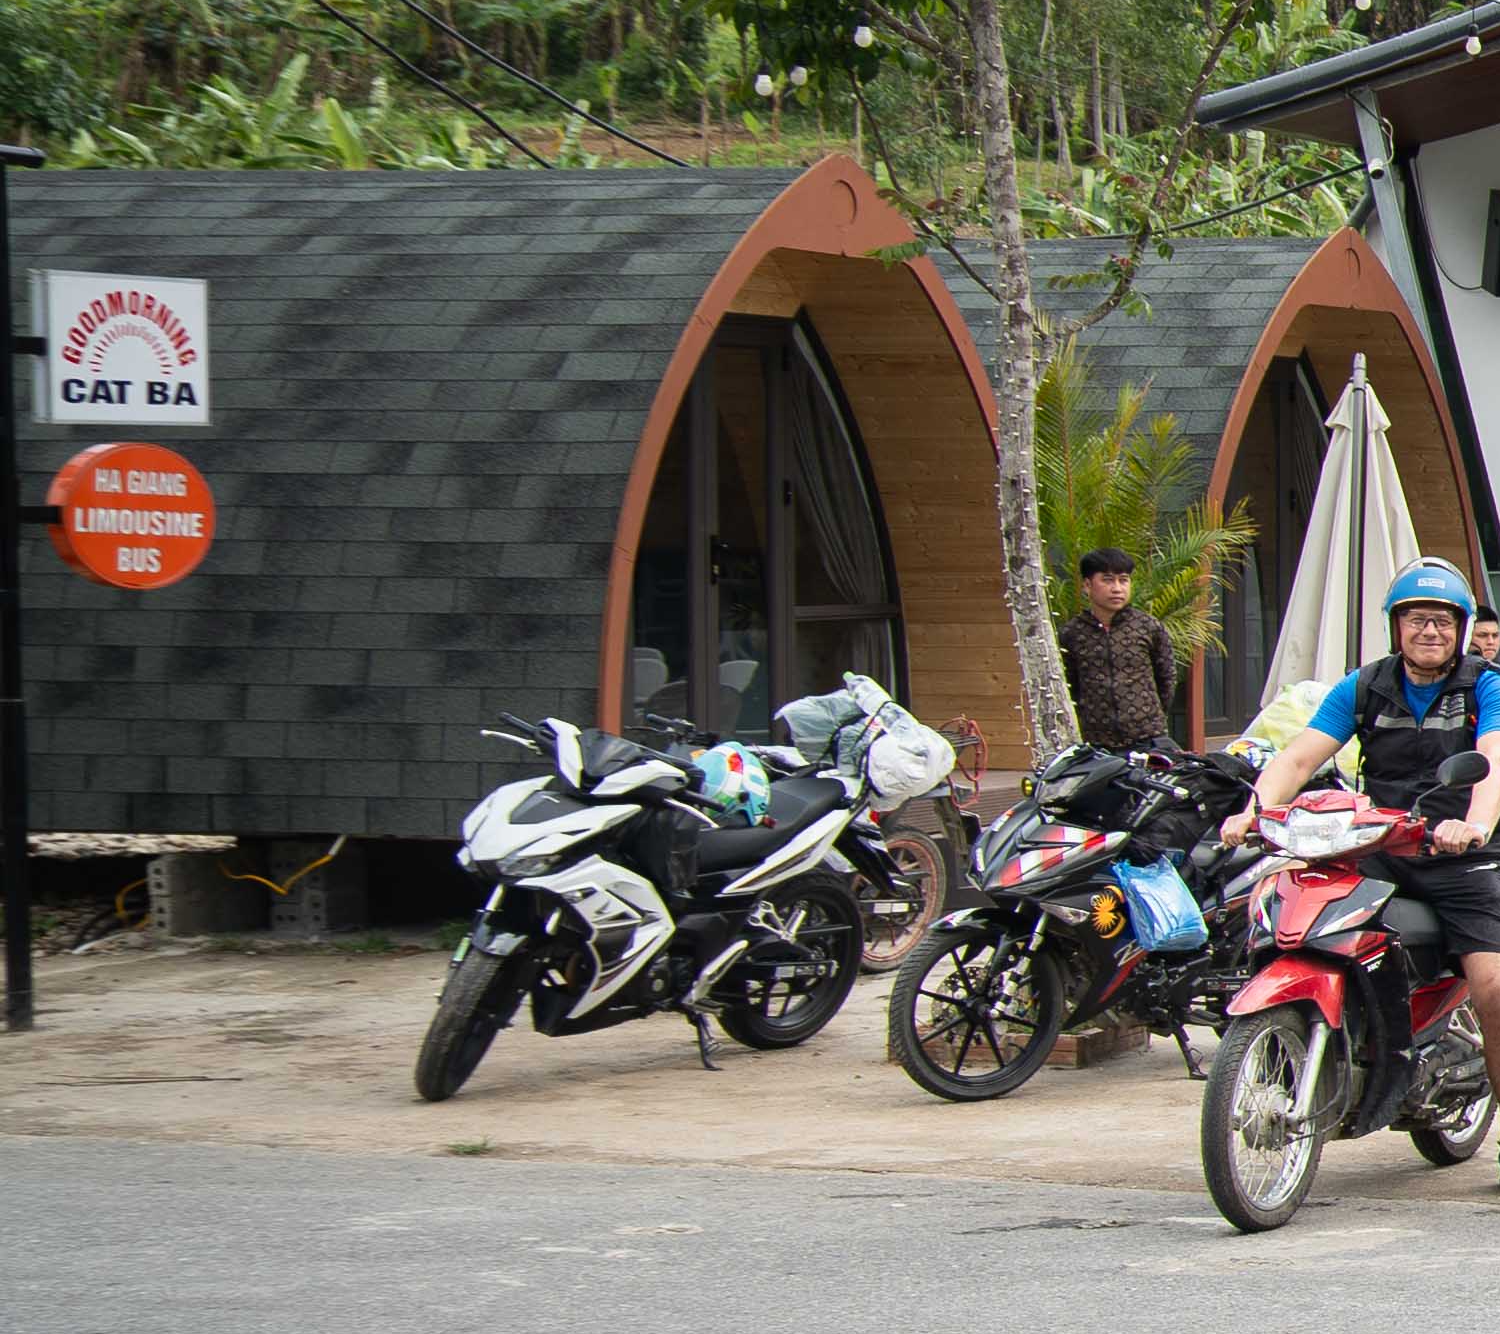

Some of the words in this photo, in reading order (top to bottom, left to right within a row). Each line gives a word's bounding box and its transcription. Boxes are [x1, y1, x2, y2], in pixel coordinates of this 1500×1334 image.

[61, 290, 198, 366] GOODMORNING
[61, 378, 132, 405] CAT
[146, 381, 198, 406] BA
[95, 468, 123, 493] HA
[127, 470, 188, 497] GIANG
[74, 507, 204, 538] LIMOUSINE
[117, 547, 162, 573] BUS
